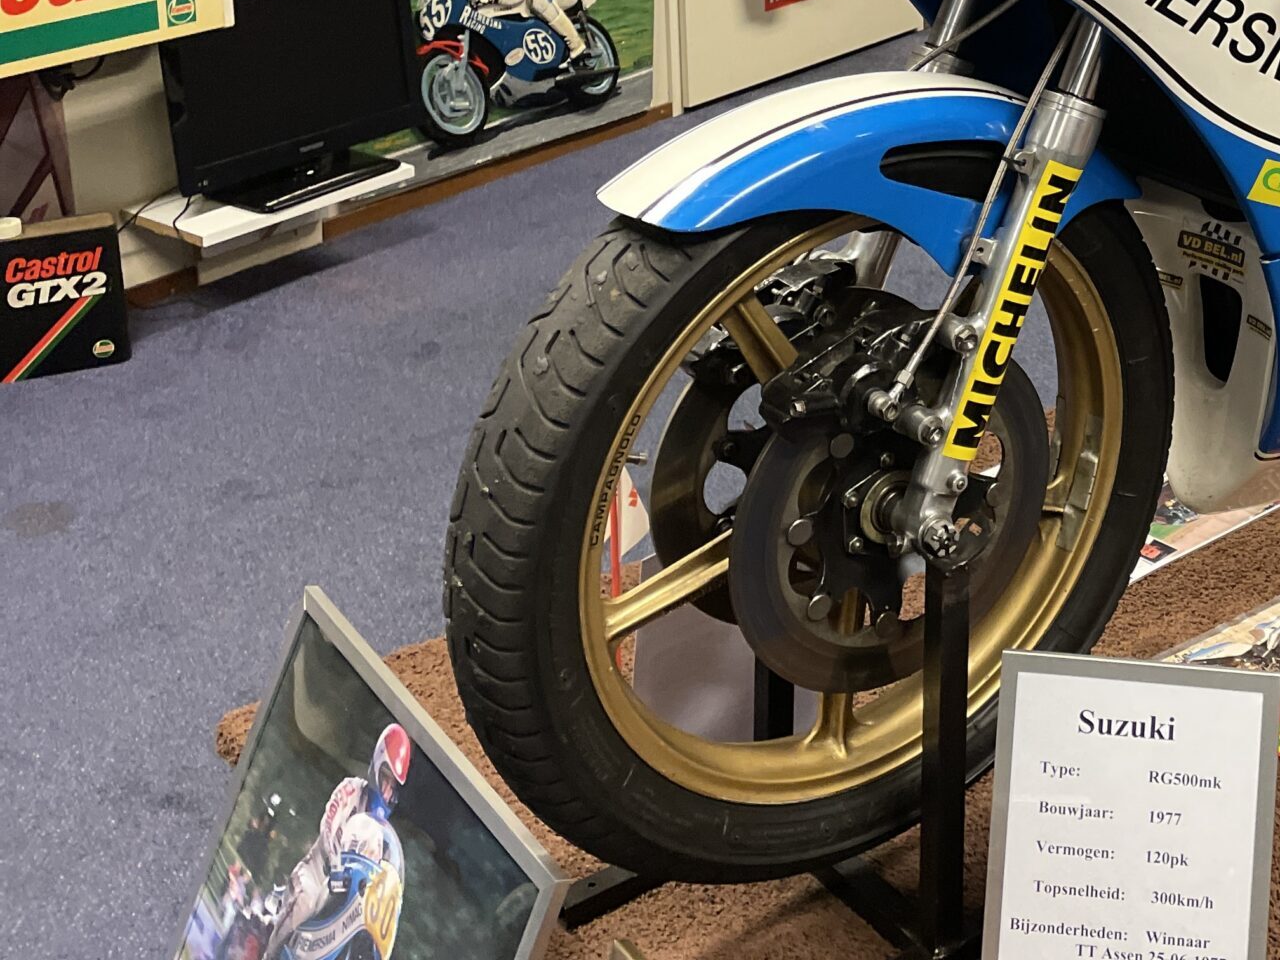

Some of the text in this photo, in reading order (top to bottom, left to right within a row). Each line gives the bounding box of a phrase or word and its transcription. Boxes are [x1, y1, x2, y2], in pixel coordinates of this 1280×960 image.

[525, 32, 553, 62] 55
[5, 246, 103, 284] Castrol
[7, 271, 107, 309] GTX2
[952, 173, 1077, 449] MICHELIN
[590, 414, 642, 546] CAMPAGNOLO
[1077, 709, 1176, 741] Suzuki
[1040, 760, 1222, 790] Type: RG500mk
[1038, 801, 1182, 826] Bouwjaar: 1977
[1036, 840, 1189, 868] Vermogen: 120pk
[1033, 879, 1214, 910] Topsnelheid: 300km/h
[1010, 917, 1211, 950] Bijzonderheden: Winnaar
[1075, 943, 1098, 958] TT
[1101, 947, 1143, 960] Assen
